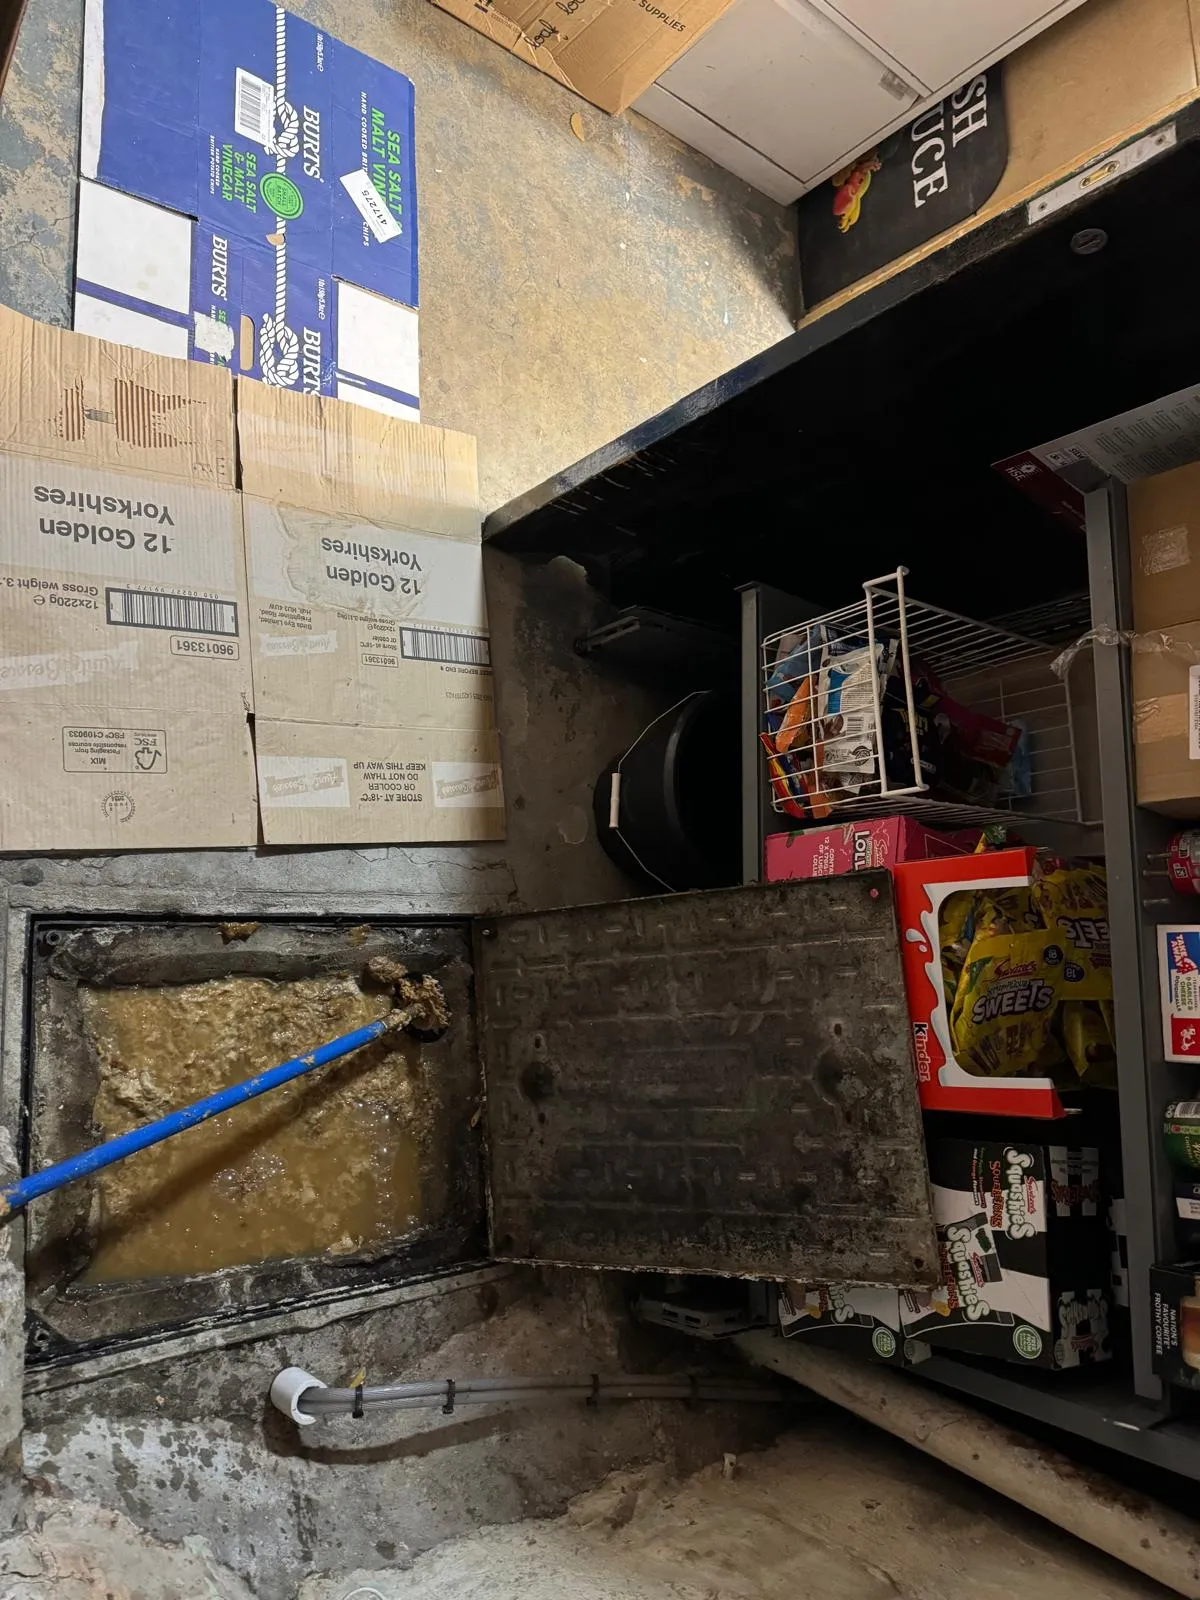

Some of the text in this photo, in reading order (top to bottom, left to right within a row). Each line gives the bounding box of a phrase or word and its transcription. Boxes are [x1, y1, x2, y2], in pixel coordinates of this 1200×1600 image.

[638, 0, 687, 32] SUPPLIES
[303, 105, 321, 178] BURTS
[371, 107, 386, 158] MALT
[222, 144, 233, 201] VINEGAR
[234, 152, 244, 203] & MALT
[246, 152, 256, 213] SEA SALT
[387, 130, 402, 214] SEA SALT
[211, 235, 228, 297] BURTS
[33, 486, 175, 526] Yorkshires
[39, 518, 172, 554] 12 Golden
[321, 538, 422, 572] Yorkshires
[17, 578, 59, 591] weight
[62, 584, 98, 597] Gross
[325, 565, 422, 596] 12 Golden
[49, 594, 98, 610] 12x220g
[283, 620, 295, 628] Eye
[175, 640, 234, 656] 96013361
[382, 643, 397, 651] Store
[364, 656, 396, 665] 96013361
[69, 731, 104, 739] C109033
[134, 738, 157, 746] FSC
[91, 747, 121, 755] Packaging
[353, 761, 426, 771] KEEP THIS WAY UP
[363, 772, 419, 781] DO NOT THAW
[368, 783, 416, 791] OR COOLER
[384, 794, 394, 802] AT
[396, 793, 423, 802] STORE
[1171, 941, 1183, 967] AWAY
[972, 979, 1056, 1024] SWEETS
[1154, 1292, 1163, 1356] FROTHY COFFEE
[1170, 1309, 1178, 1347] NATION'S
